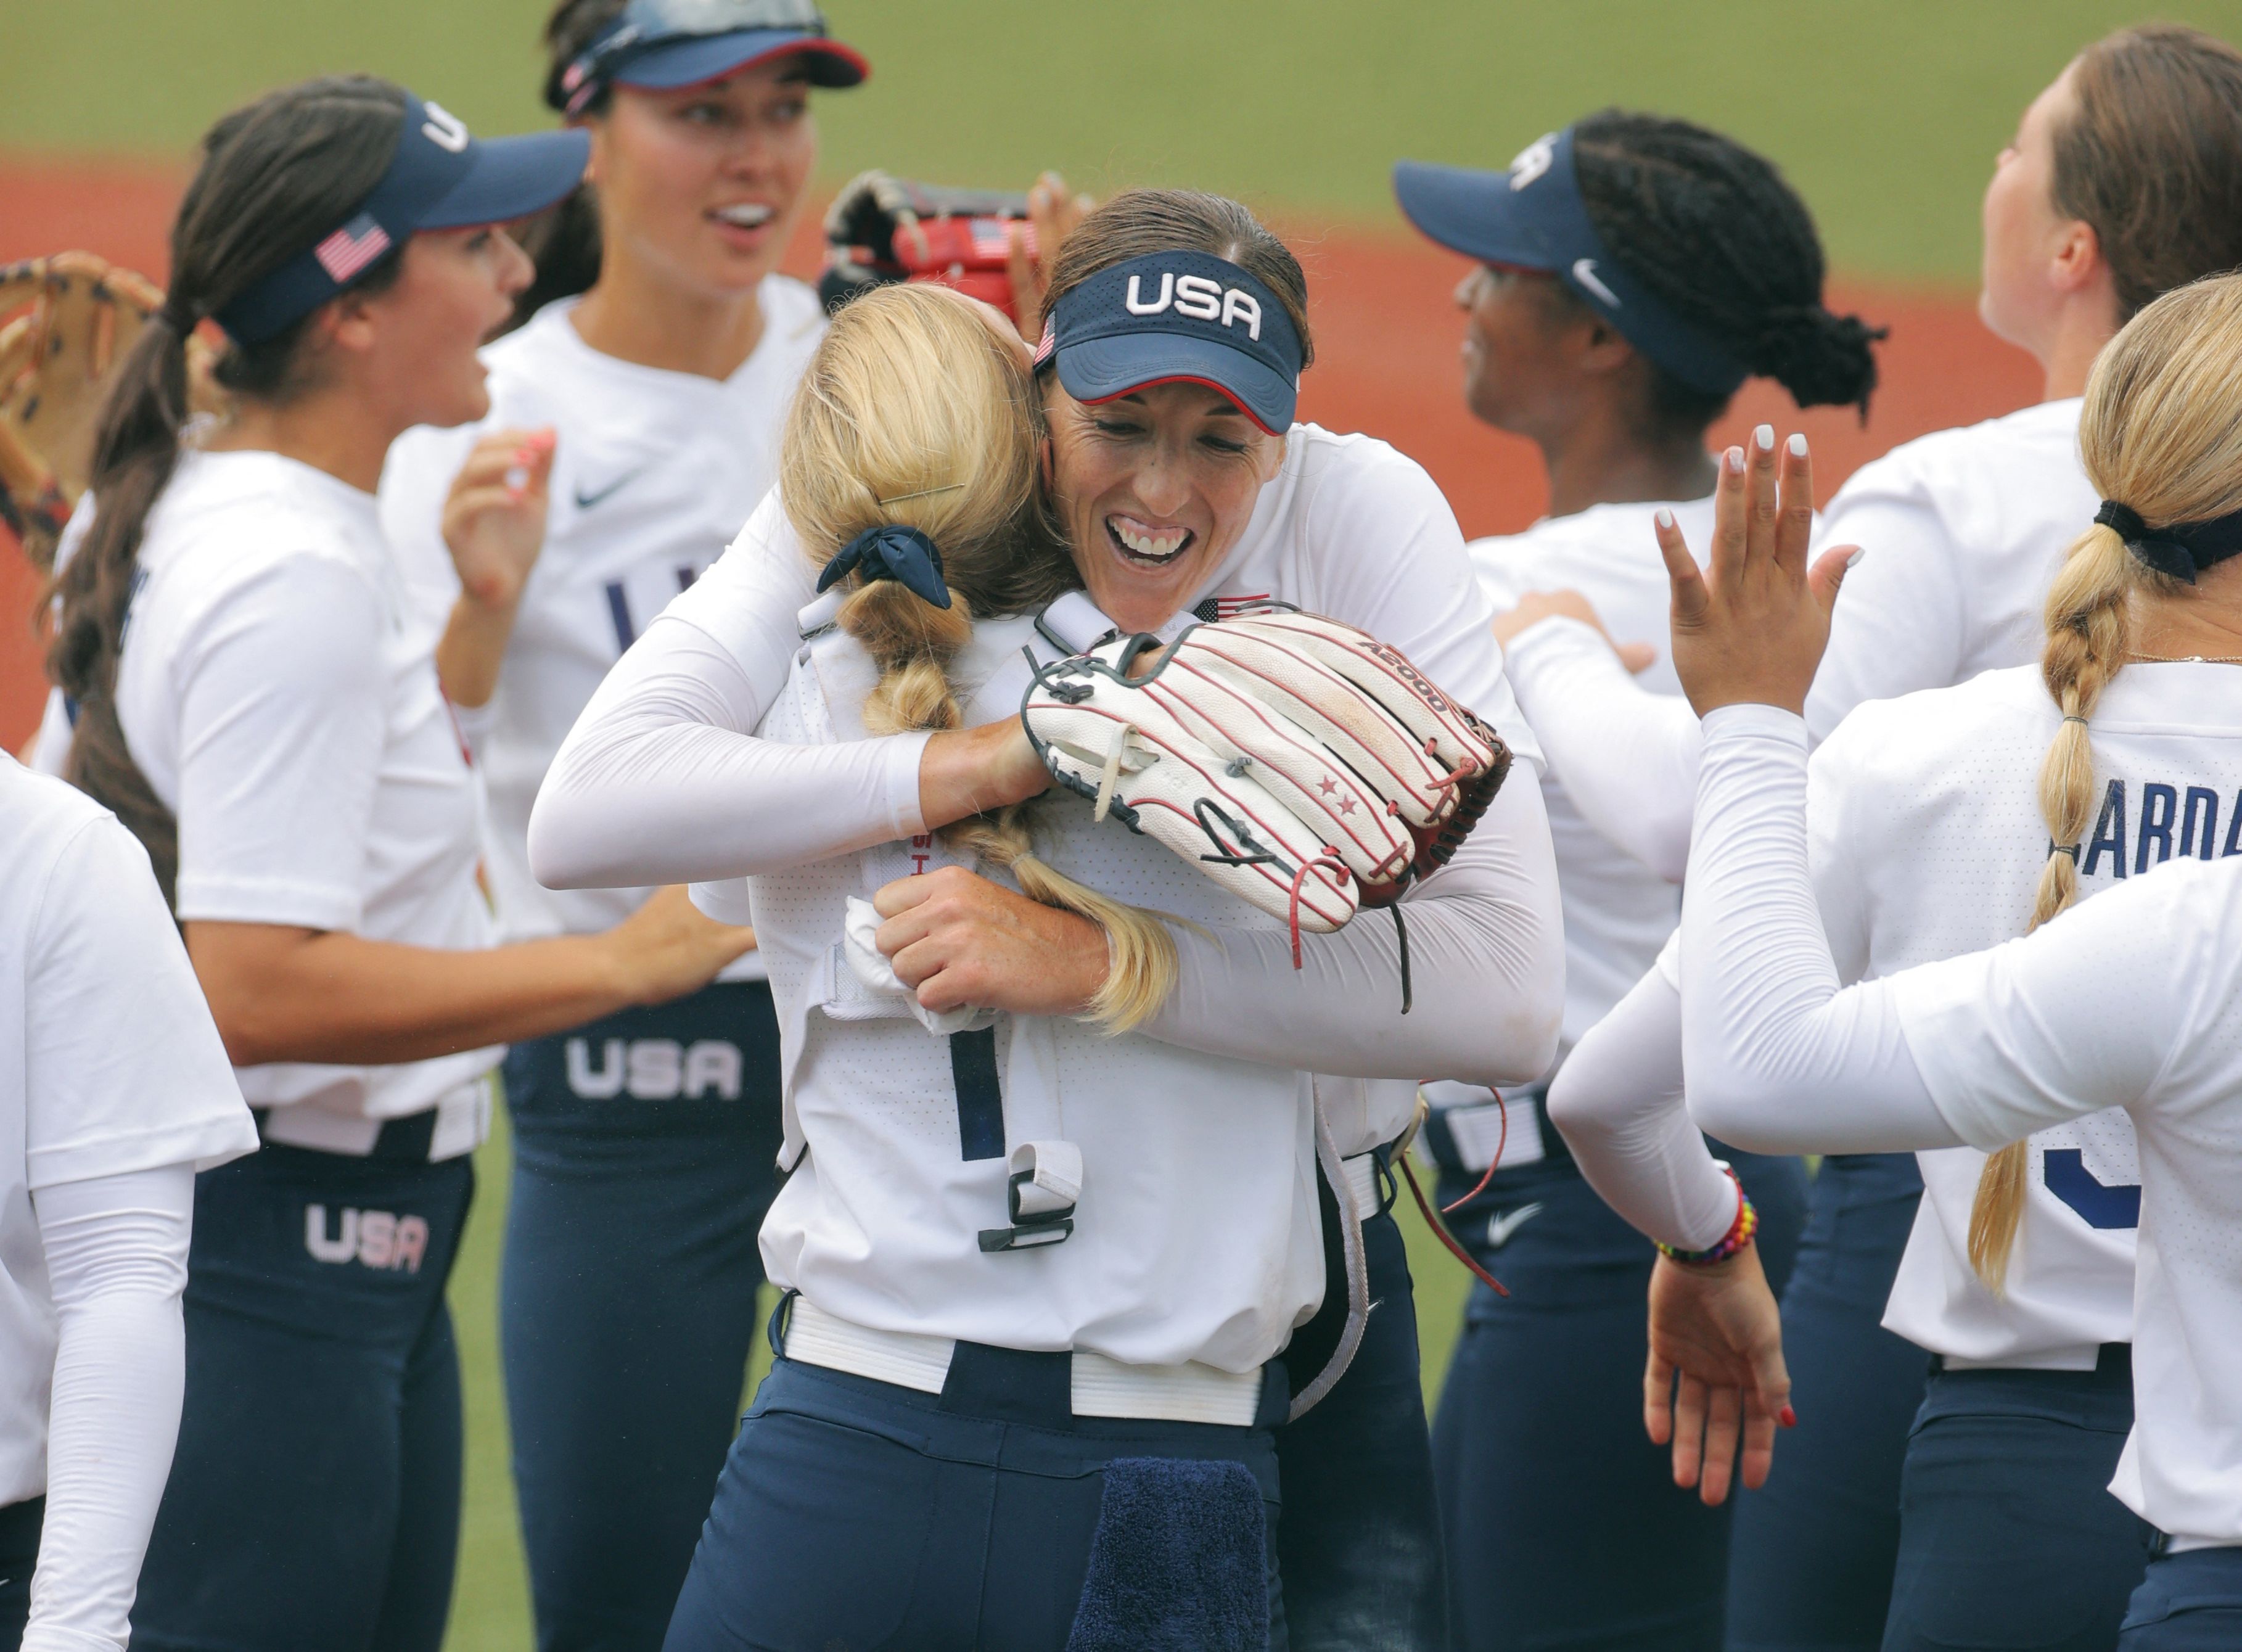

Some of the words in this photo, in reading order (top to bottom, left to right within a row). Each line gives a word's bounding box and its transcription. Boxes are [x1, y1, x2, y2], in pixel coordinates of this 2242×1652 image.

[1125, 273, 1262, 342] USA
[1356, 642, 1448, 712] A2000
[565, 1035, 742, 1100] USA
[305, 1203, 429, 1275] USA
